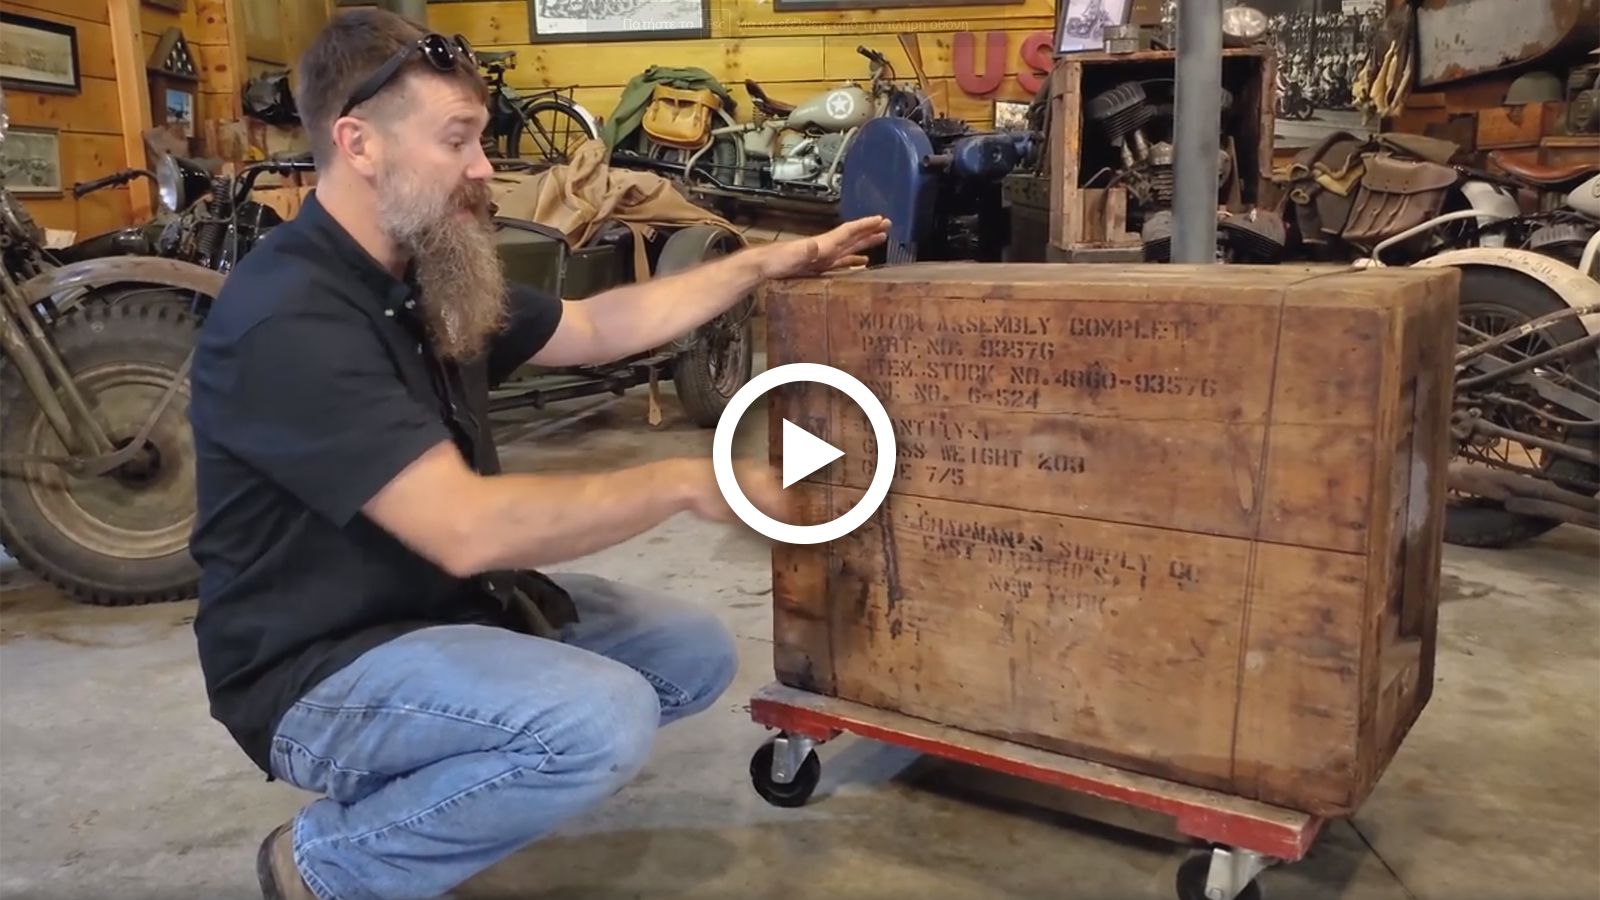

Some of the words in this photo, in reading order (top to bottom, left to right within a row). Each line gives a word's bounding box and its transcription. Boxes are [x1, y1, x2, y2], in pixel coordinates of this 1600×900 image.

[859, 312, 925, 333] MOTOR
[936, 314, 1051, 336] ASSEMBLY
[979, 340, 1055, 361] 93576
[862, 438, 927, 459] GSS
[940, 444, 1023, 468] WEIGHT
[926, 462, 965, 486] 7/5
